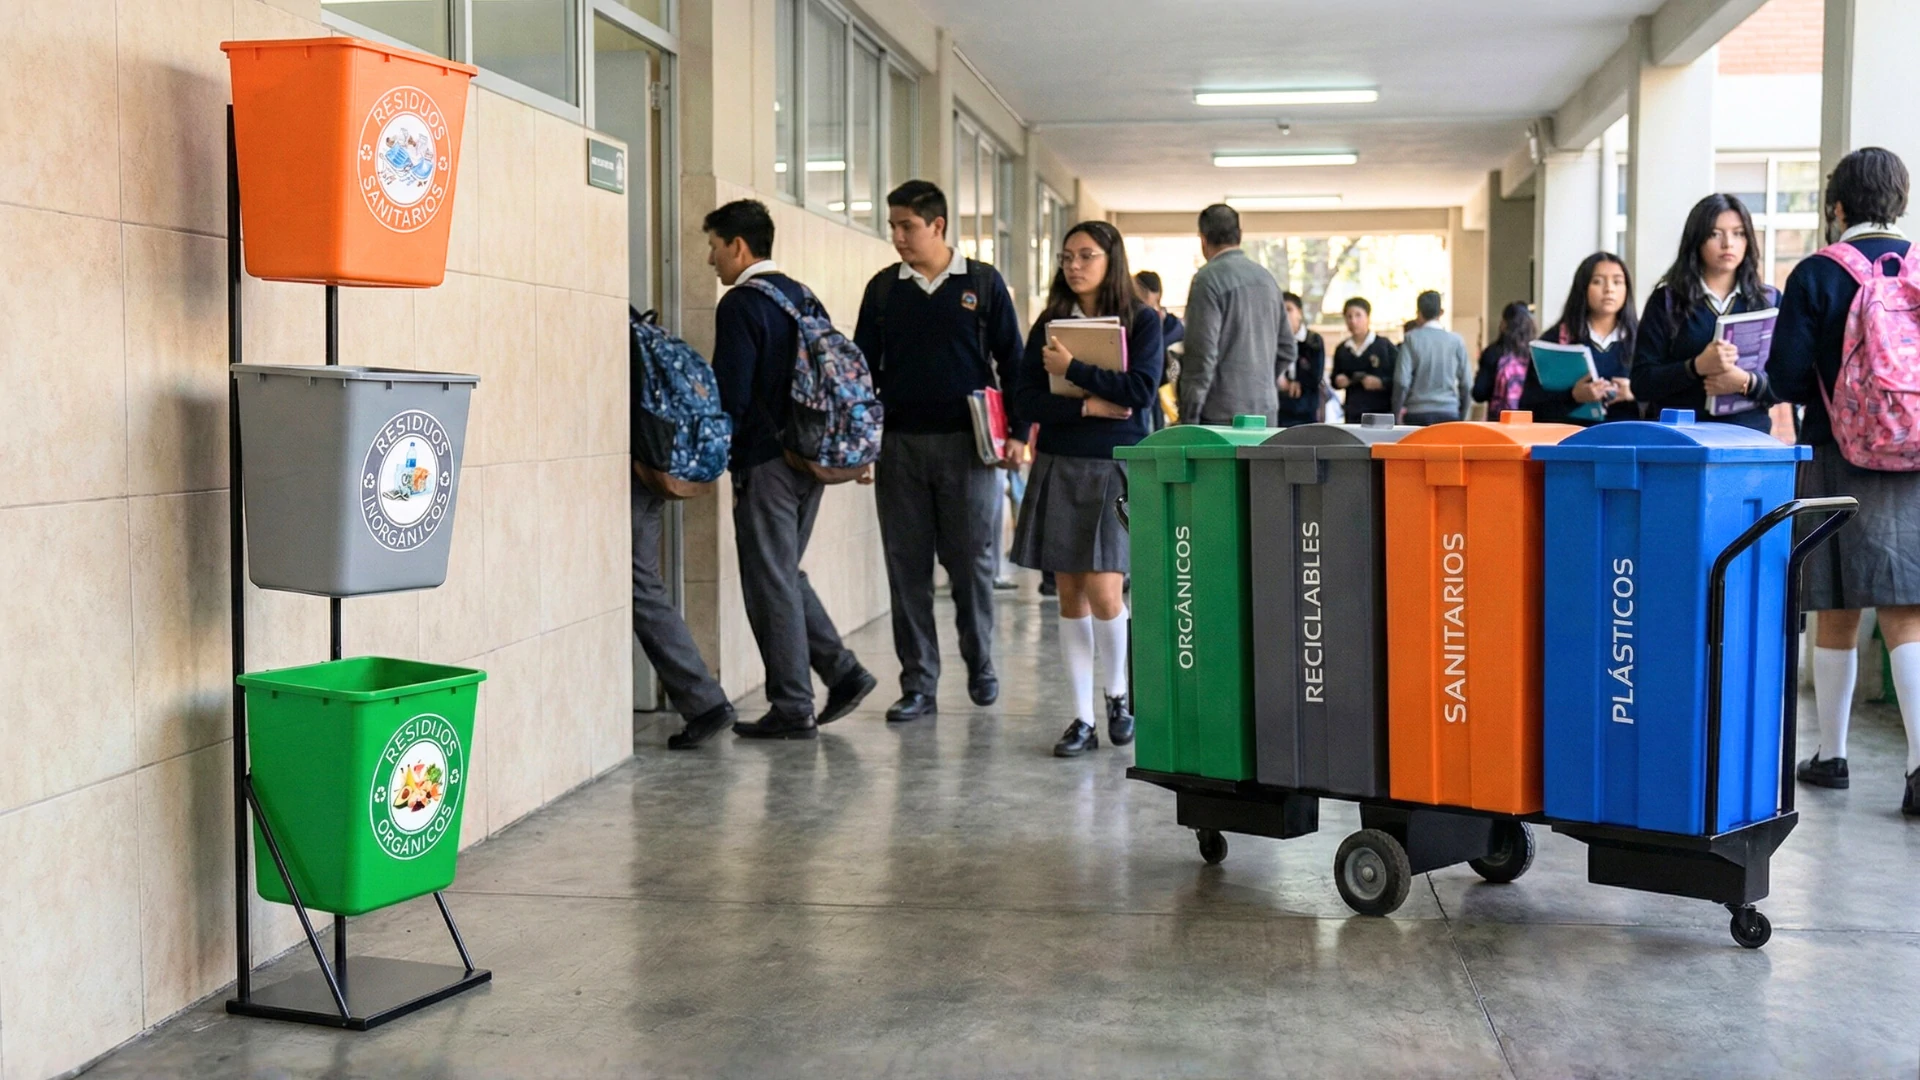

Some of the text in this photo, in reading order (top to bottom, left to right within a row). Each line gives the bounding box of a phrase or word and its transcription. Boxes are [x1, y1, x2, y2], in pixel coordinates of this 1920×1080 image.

[373, 92, 445, 141] RESIDUOS
[364, 175, 443, 227] SANITARIOS
[376, 415, 448, 456] RESIDUOS
[363, 491, 447, 547] INORGÁNICOS
[1302, 521, 1324, 703] RECICLABLES
[1443, 533, 1467, 723] SANITARIOS
[1607, 558, 1634, 725] PLÁSTICOS
[377, 804, 452, 855] ORGÁNICOS
